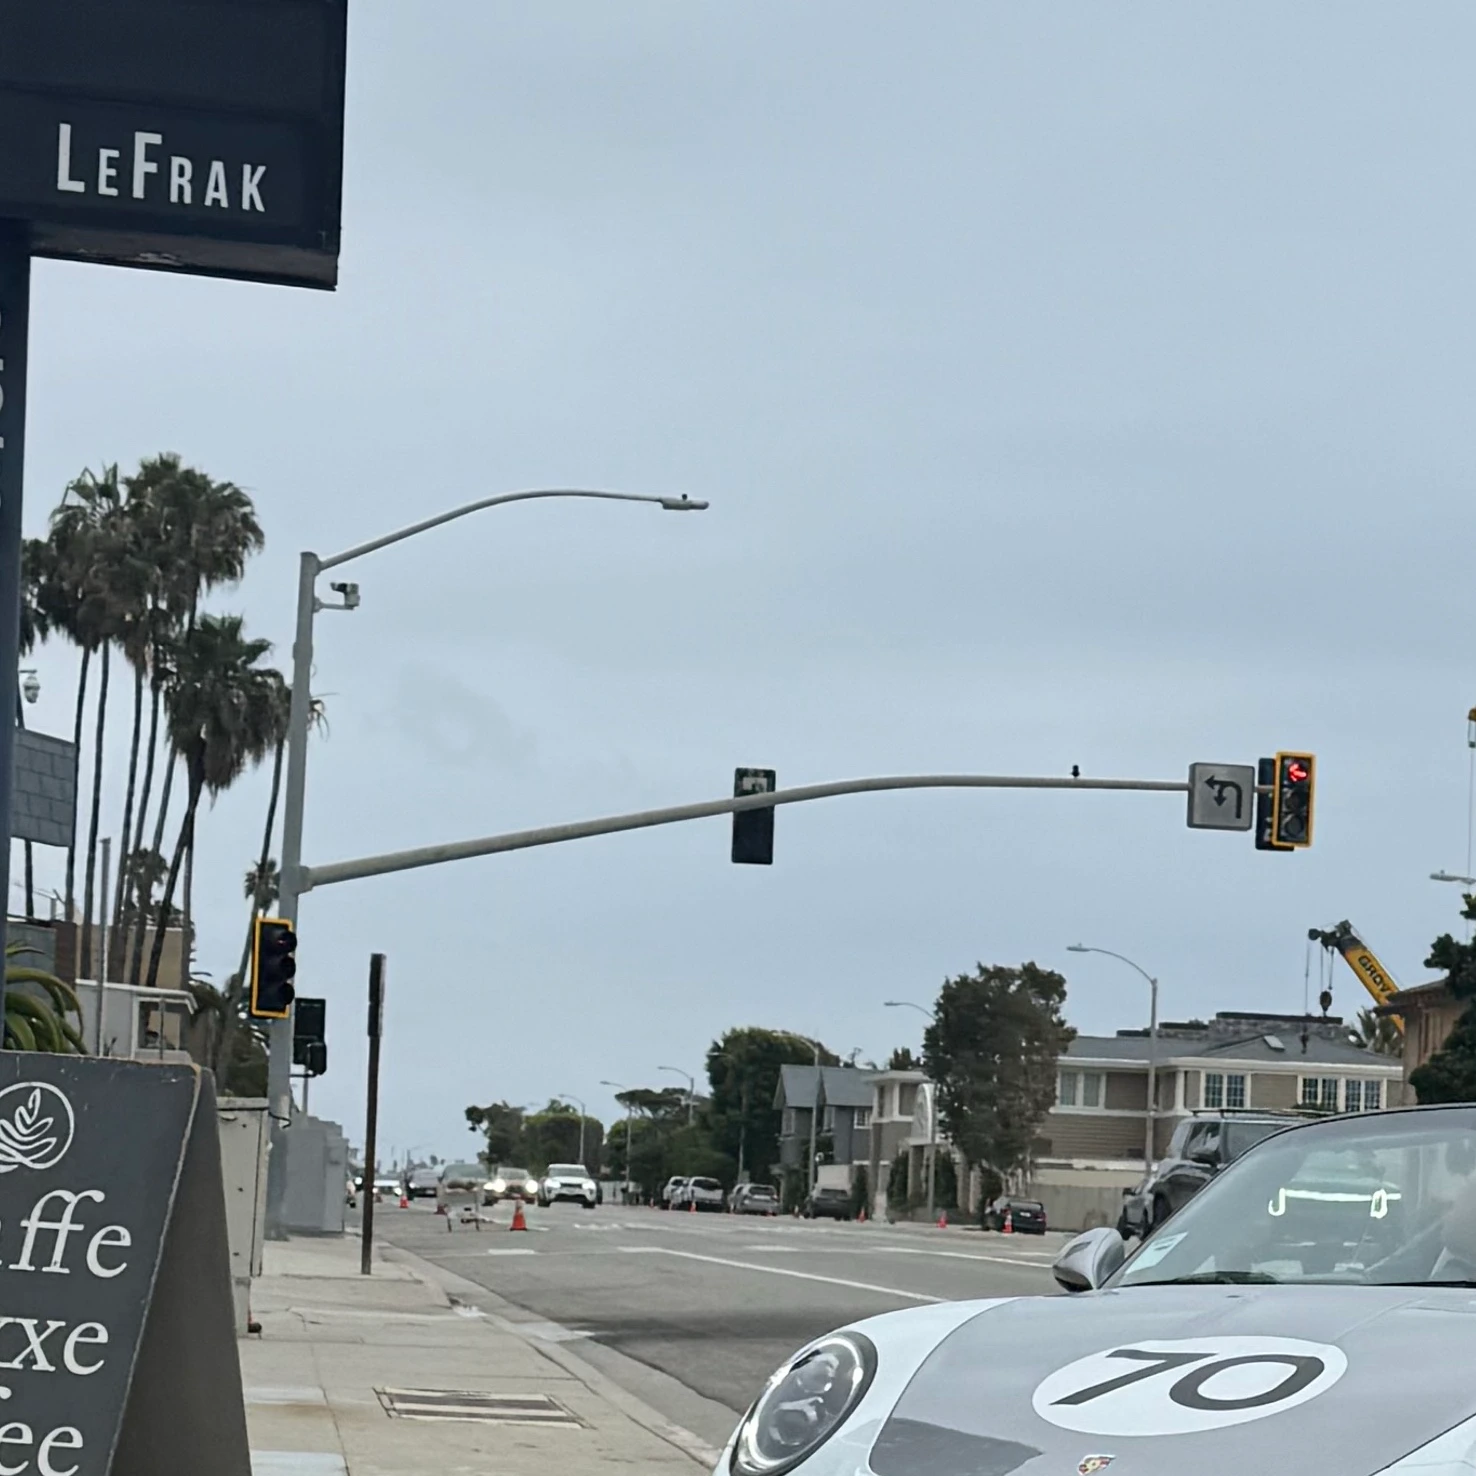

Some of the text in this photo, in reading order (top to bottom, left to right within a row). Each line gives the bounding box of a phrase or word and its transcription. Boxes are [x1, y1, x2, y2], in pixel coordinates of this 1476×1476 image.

[1358, 955, 1393, 1000] GROV
[0, 1189, 132, 1278] ffe
[1049, 1349, 1325, 1411] 70
